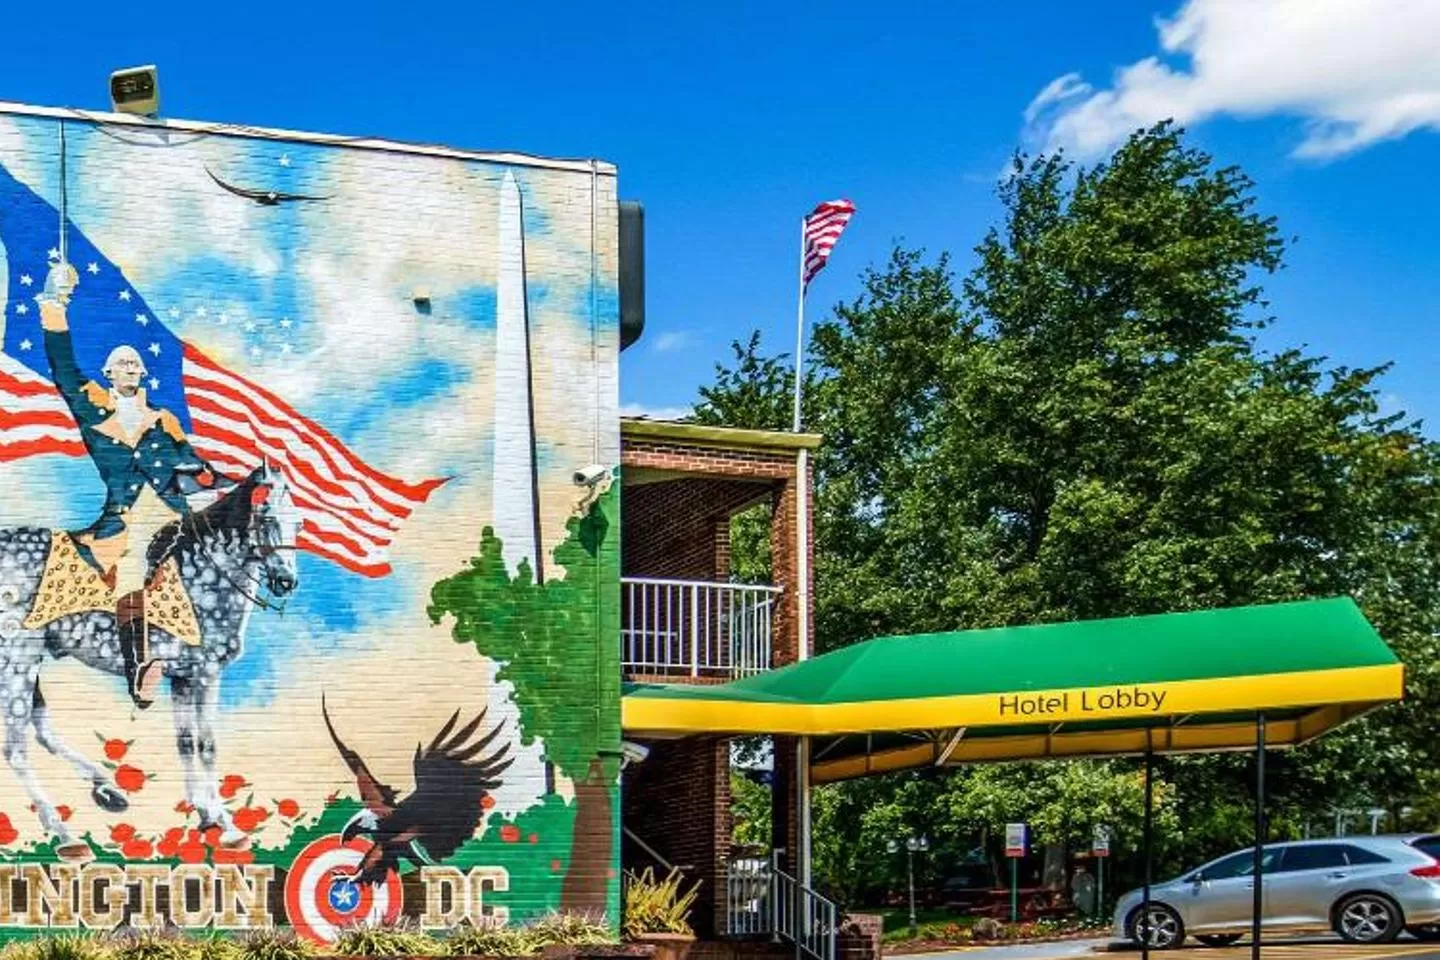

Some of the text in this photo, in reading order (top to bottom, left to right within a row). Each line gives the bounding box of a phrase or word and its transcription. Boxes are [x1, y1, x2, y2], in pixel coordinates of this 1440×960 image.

[999, 687, 1167, 715] Hotel Lobby
[419, 865, 510, 930] DC
